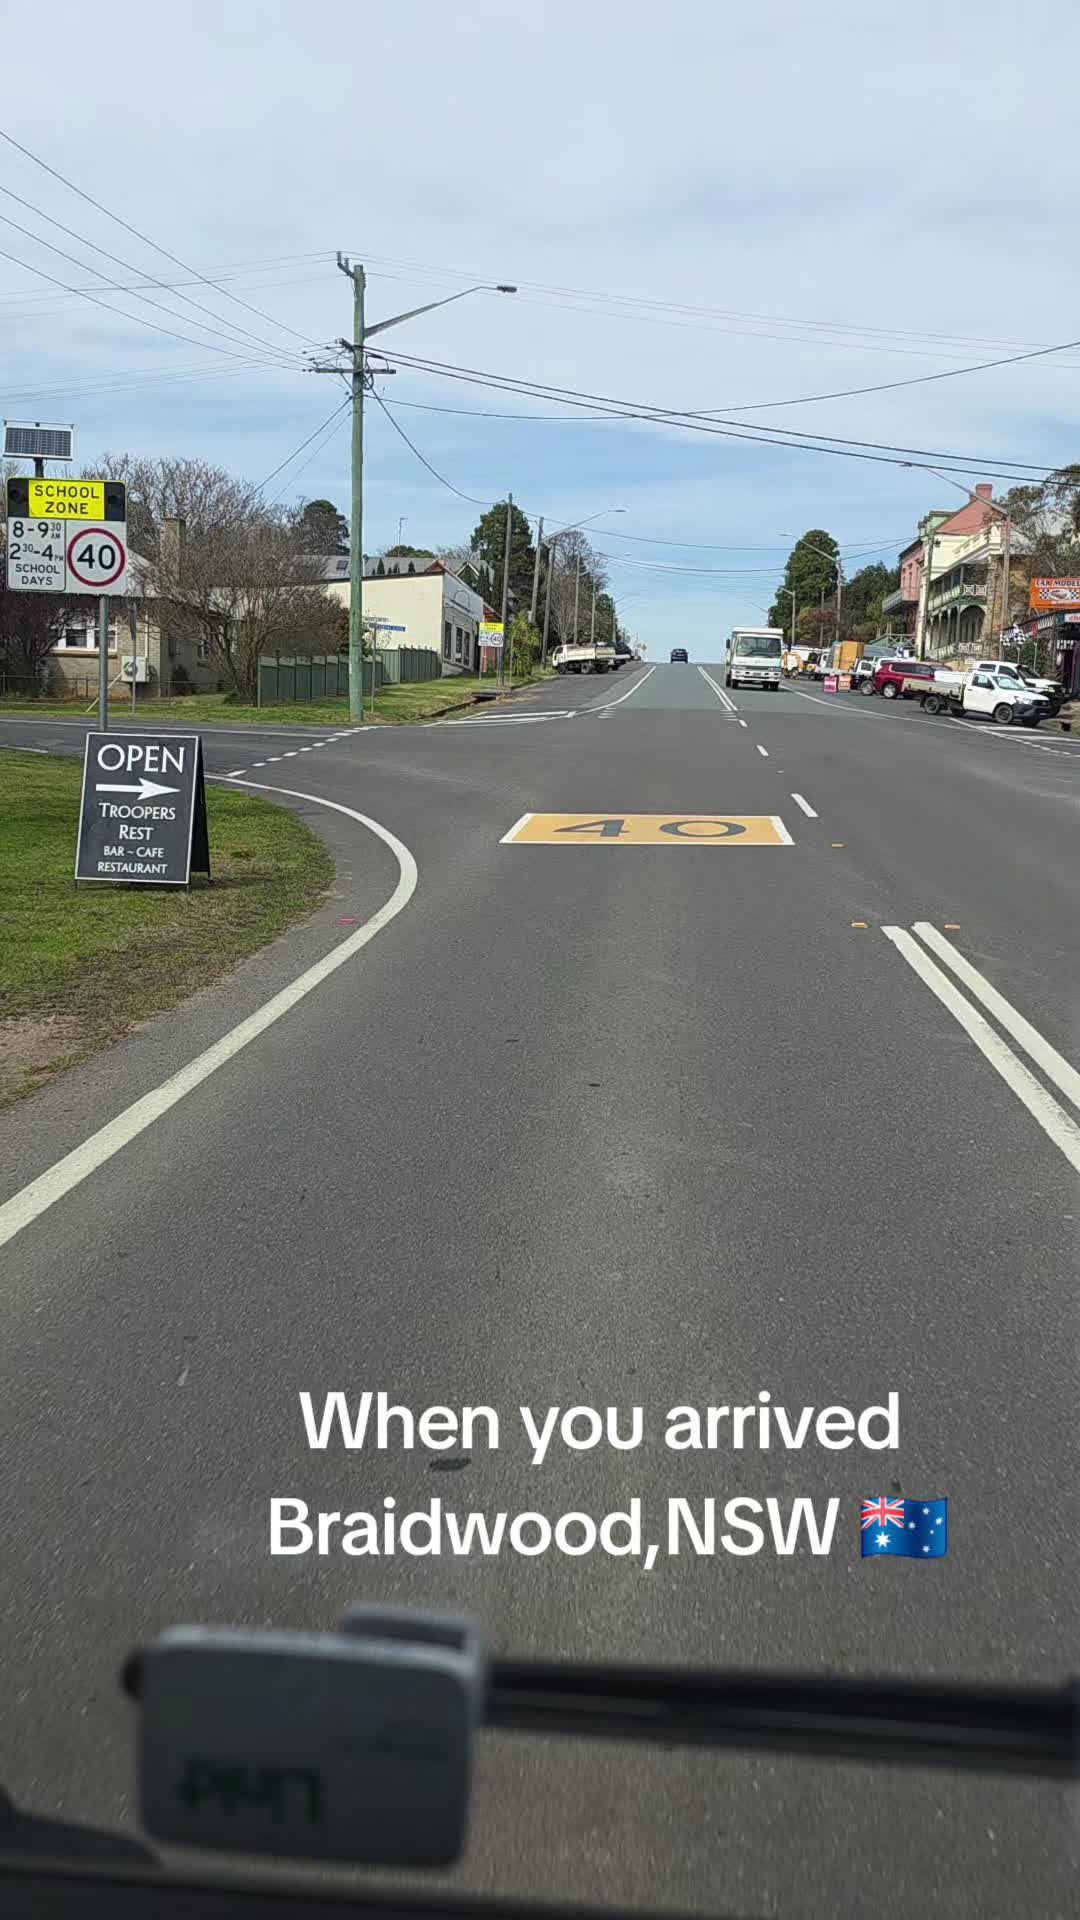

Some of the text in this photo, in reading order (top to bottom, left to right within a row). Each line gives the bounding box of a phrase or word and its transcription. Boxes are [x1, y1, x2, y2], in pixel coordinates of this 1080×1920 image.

[34, 485, 100, 499] SCHOOL
[45, 501, 89, 515] ZONE
[77, 544, 116, 570] 40
[15, 564, 61, 575] SCHOOL
[21, 575, 53, 586] DAYS
[97, 743, 185, 774] OPEN
[98, 802, 176, 820] TROOPERS
[119, 825, 154, 841] REST
[552, 818, 747, 838] 40
[103, 845, 125, 857] BAR
[136, 846, 165, 858] CAFE
[97, 861, 168, 874] RESTAURANT
